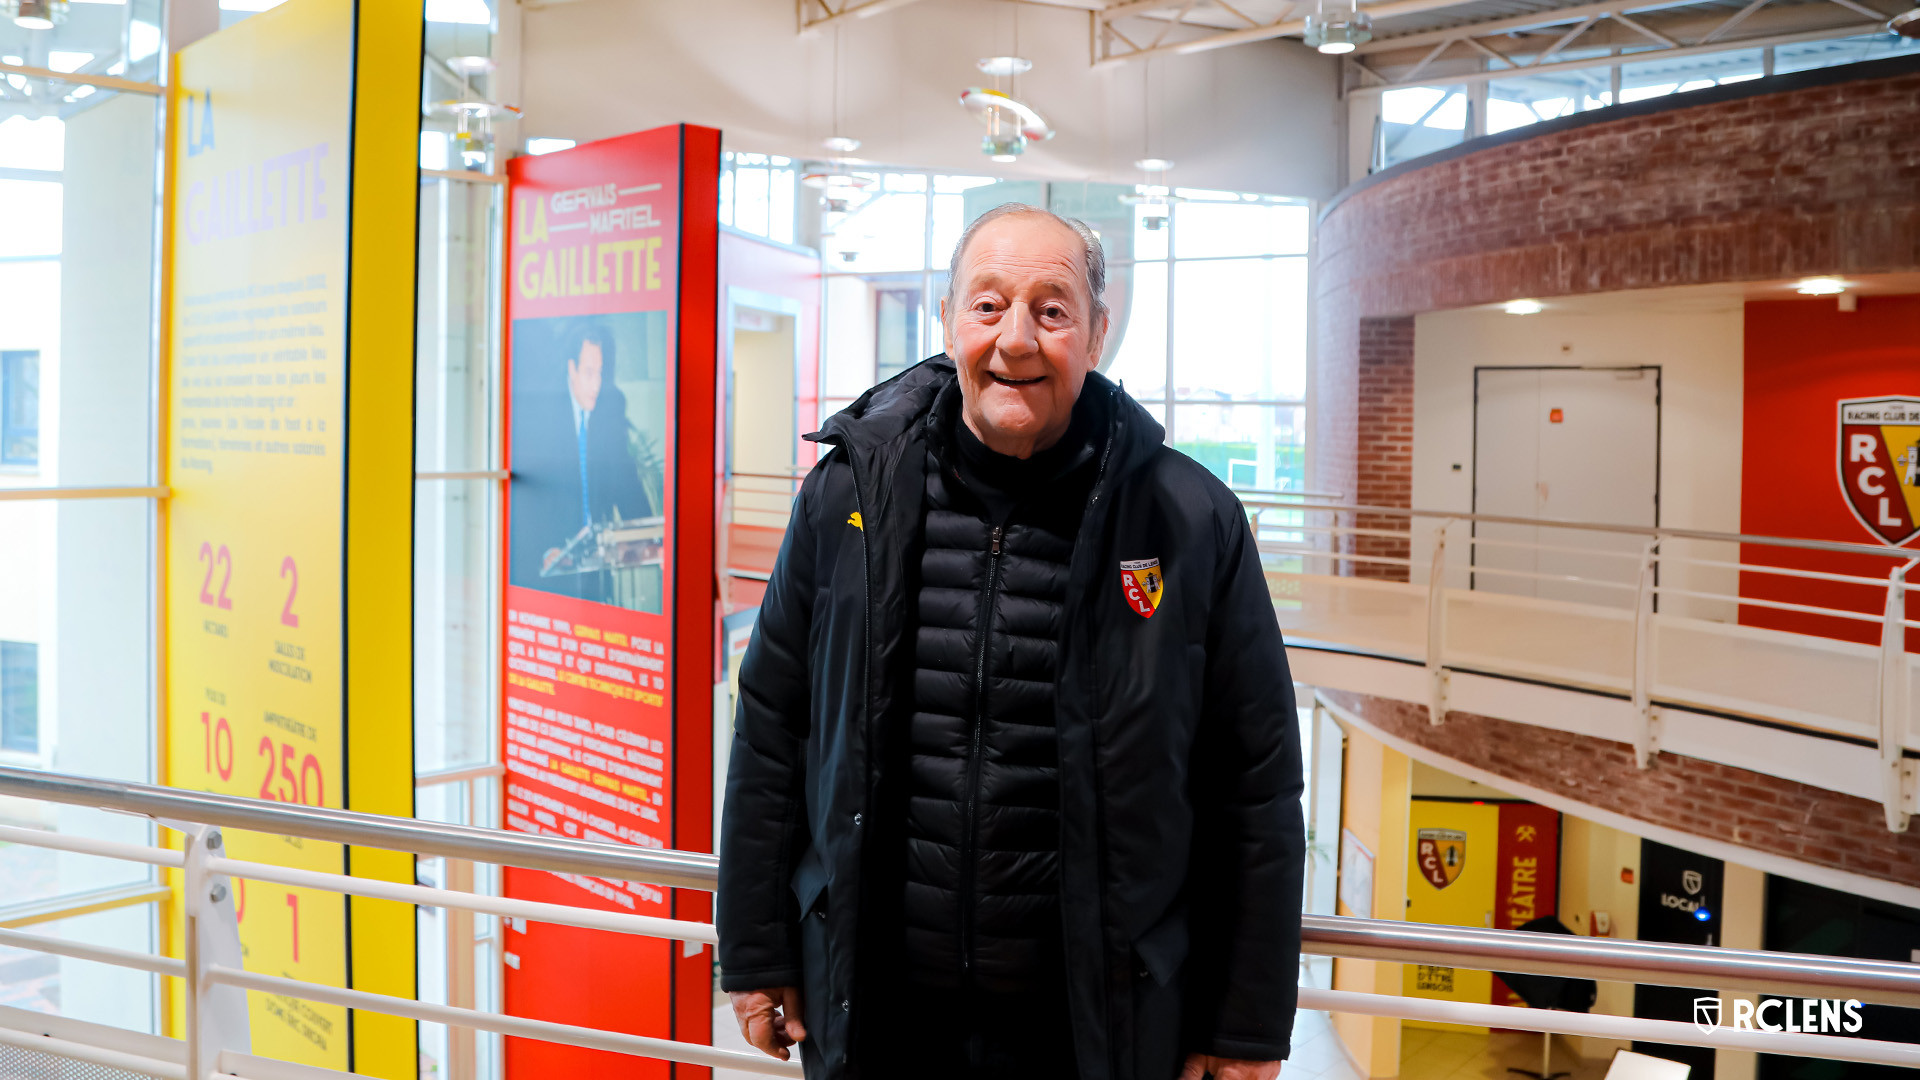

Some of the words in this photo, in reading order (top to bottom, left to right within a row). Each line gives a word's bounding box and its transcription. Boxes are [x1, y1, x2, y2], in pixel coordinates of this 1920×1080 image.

[187, 89, 215, 157] LA
[184, 141, 330, 246] GAILLETTE
[518, 195, 549, 246] LA
[551, 183, 618, 214] GERVAIS
[589, 204, 662, 235] MARTEL
[518, 236, 662, 301] GAILLETTE
[1848, 411, 1880, 421] RACING
[1884, 411, 1906, 421] CLUB
[199, 541, 232, 611] 22
[280, 555, 299, 628] 2
[201, 711, 233, 782] 10
[258, 735, 324, 807] 250
[286, 893, 299, 963] 1
